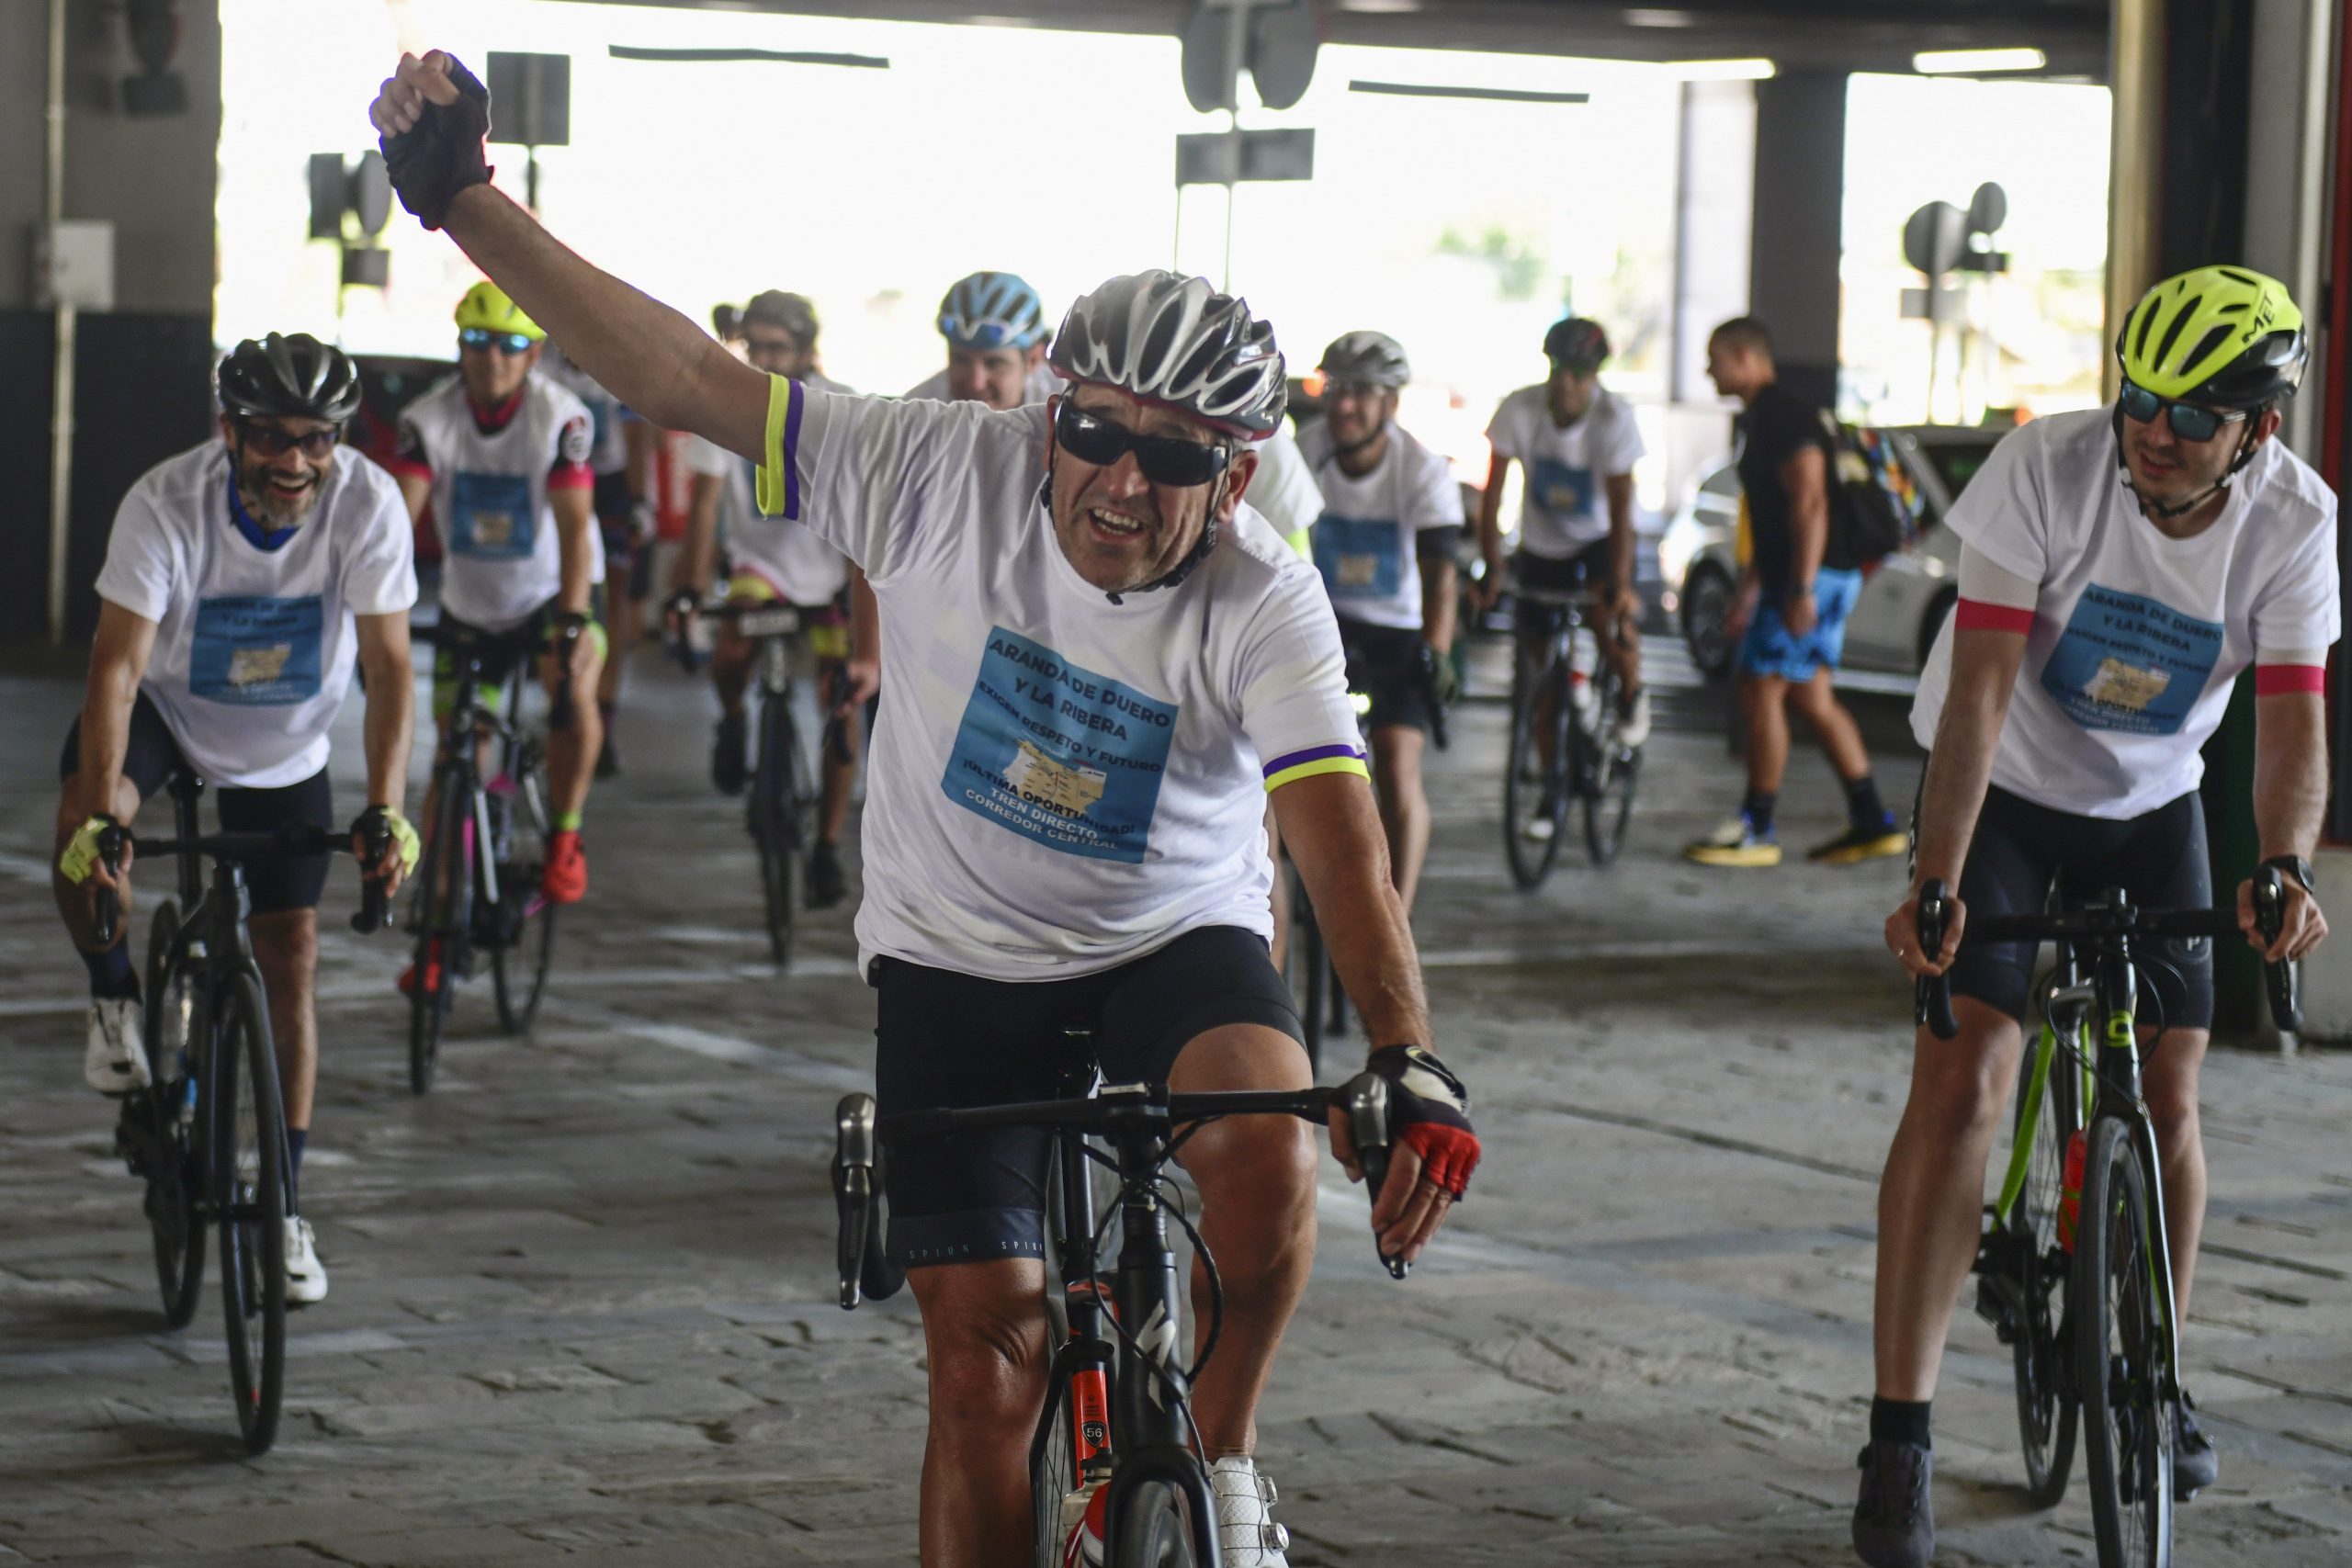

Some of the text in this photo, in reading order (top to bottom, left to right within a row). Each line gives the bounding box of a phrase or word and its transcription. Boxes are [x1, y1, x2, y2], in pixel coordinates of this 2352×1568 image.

[2242, 288, 2274, 344] MET
[2116, 617, 2134, 632] LA
[2150, 606, 2169, 623] DE
[2172, 618, 2222, 641] DUERO
[989, 638, 1170, 728] ARANDA DE DUERO
[1015, 676, 1127, 741] Y LA RIBERA
[978, 680, 1021, 719] EXIGEN
[1021, 716, 1082, 753] RESPETO
[1086, 746, 1098, 758] Y
[1099, 750, 1162, 773] FUTURO
[966, 788, 1119, 851] CORREDOR CENTRAL
[990, 786, 1099, 840] TREN DIRECTO
[909, 1244, 970, 1260] SPIUK
[1086, 1427, 1102, 1438] 56
